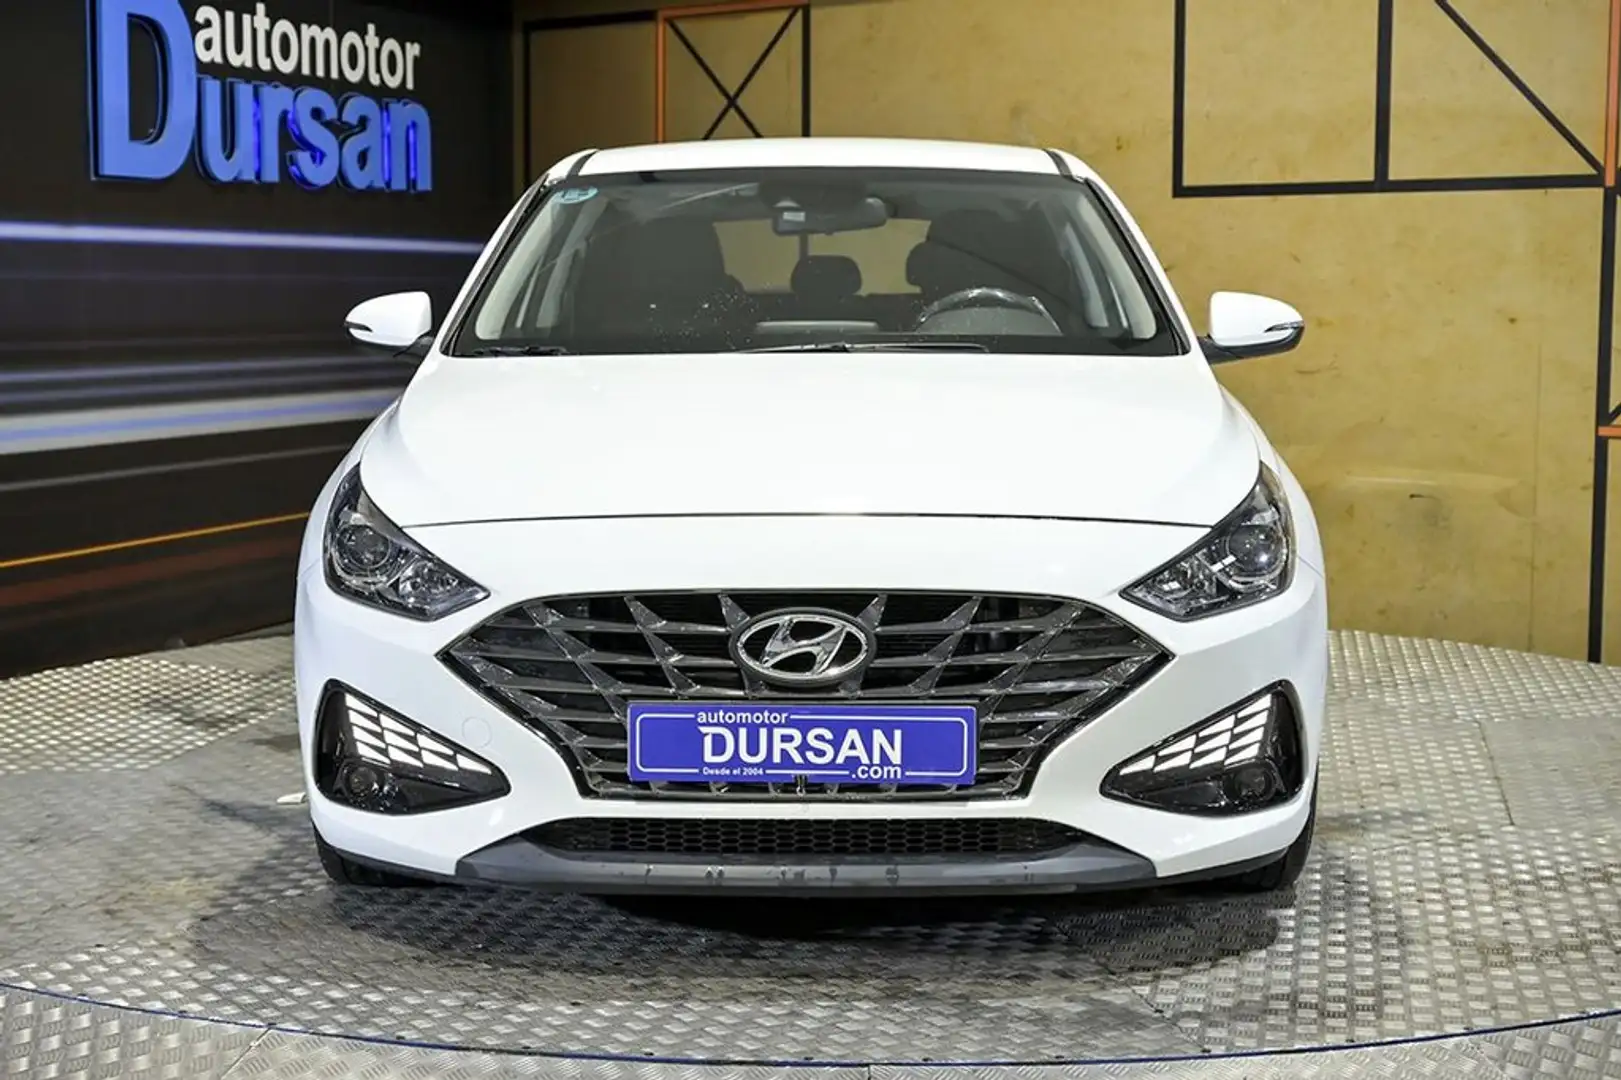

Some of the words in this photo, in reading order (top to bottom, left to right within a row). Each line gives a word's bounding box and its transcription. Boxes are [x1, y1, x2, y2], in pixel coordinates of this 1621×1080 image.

[194, 2, 421, 90] automotor
[89, 0, 432, 191] Dursan
[696, 710, 789, 724] automotor
[698, 726, 902, 765] DURSAN
[702, 766, 731, 776] Desde
[851, 764, 902, 780] .com
